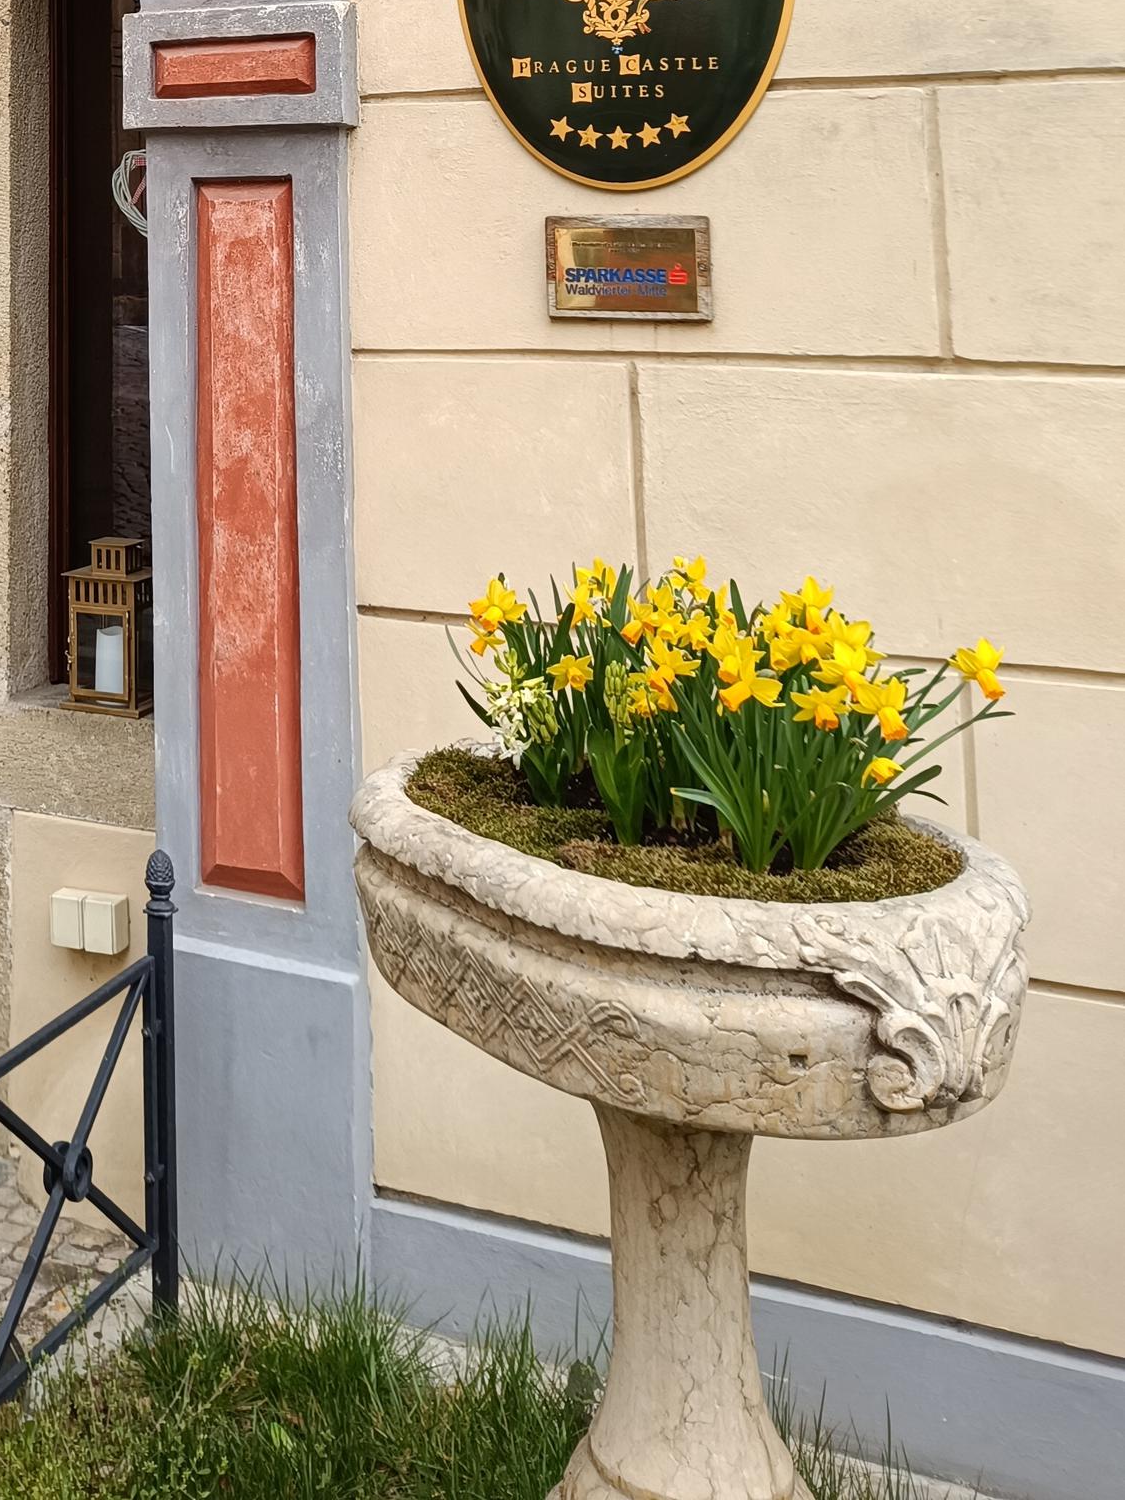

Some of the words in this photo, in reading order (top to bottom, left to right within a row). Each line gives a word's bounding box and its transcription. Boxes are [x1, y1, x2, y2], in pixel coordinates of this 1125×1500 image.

[515, 57, 611, 77] PRAGUE
[622, 55, 720, 74] CASTLE
[574, 83, 665, 101] SUITES
[565, 267, 667, 283] SPARKASSE
